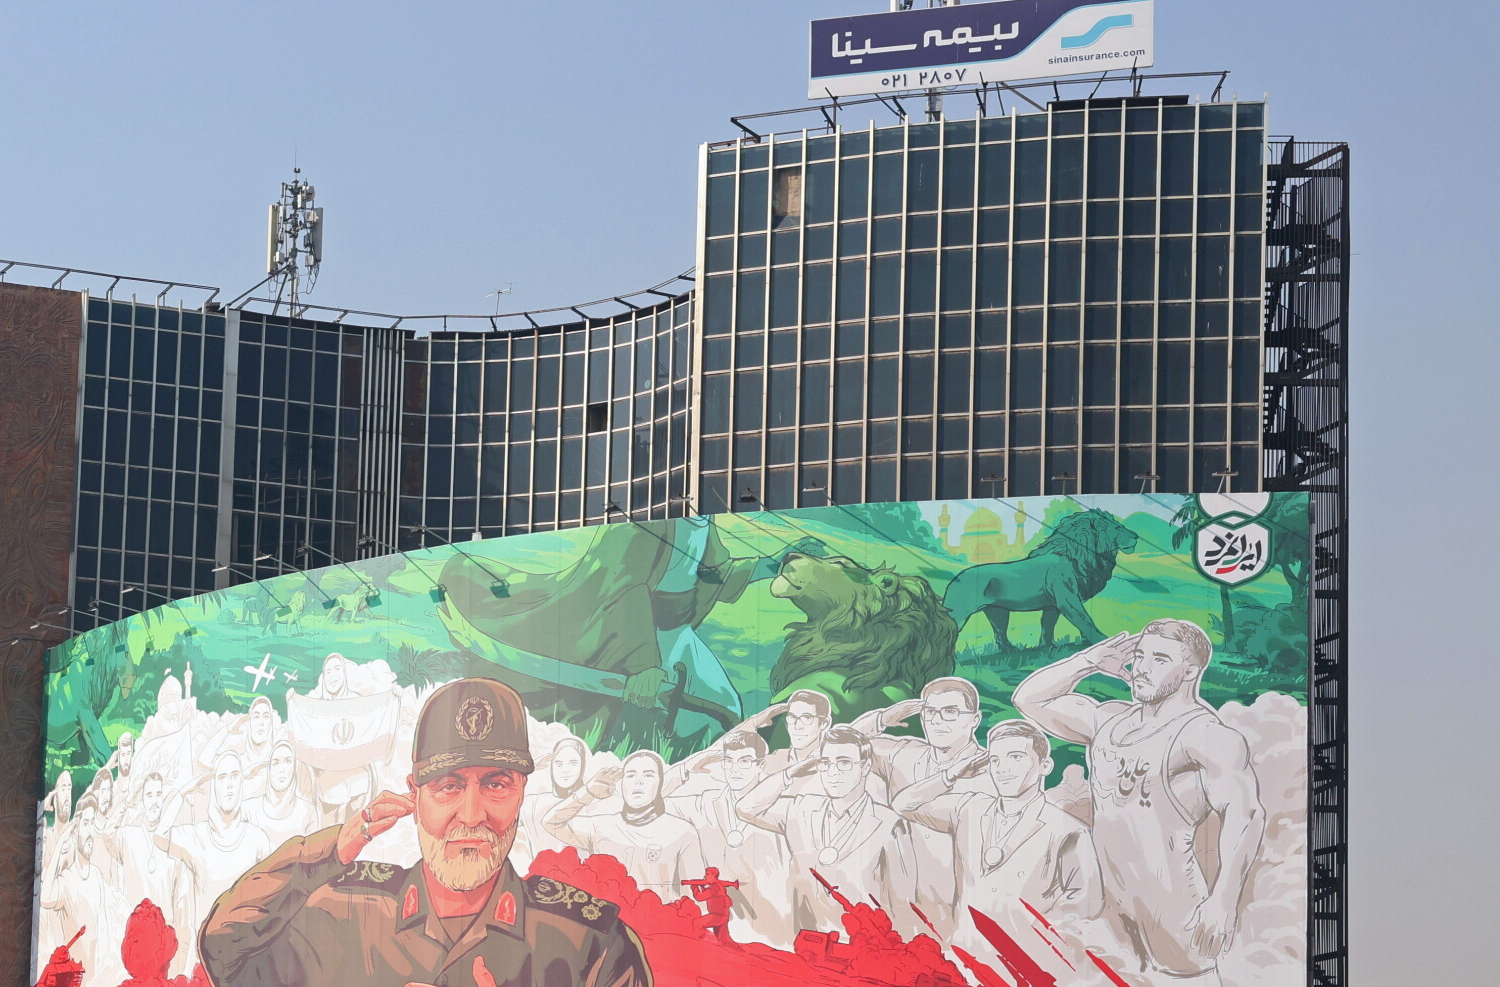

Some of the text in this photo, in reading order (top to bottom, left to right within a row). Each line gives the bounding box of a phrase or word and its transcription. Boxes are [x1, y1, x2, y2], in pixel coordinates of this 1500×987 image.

[832, 21, 1019, 65] بیمه سینا
[1048, 48, 1145, 65] sinainsurance.com
[881, 68, 966, 87] ۰۲۱ ۲۸۰۷
